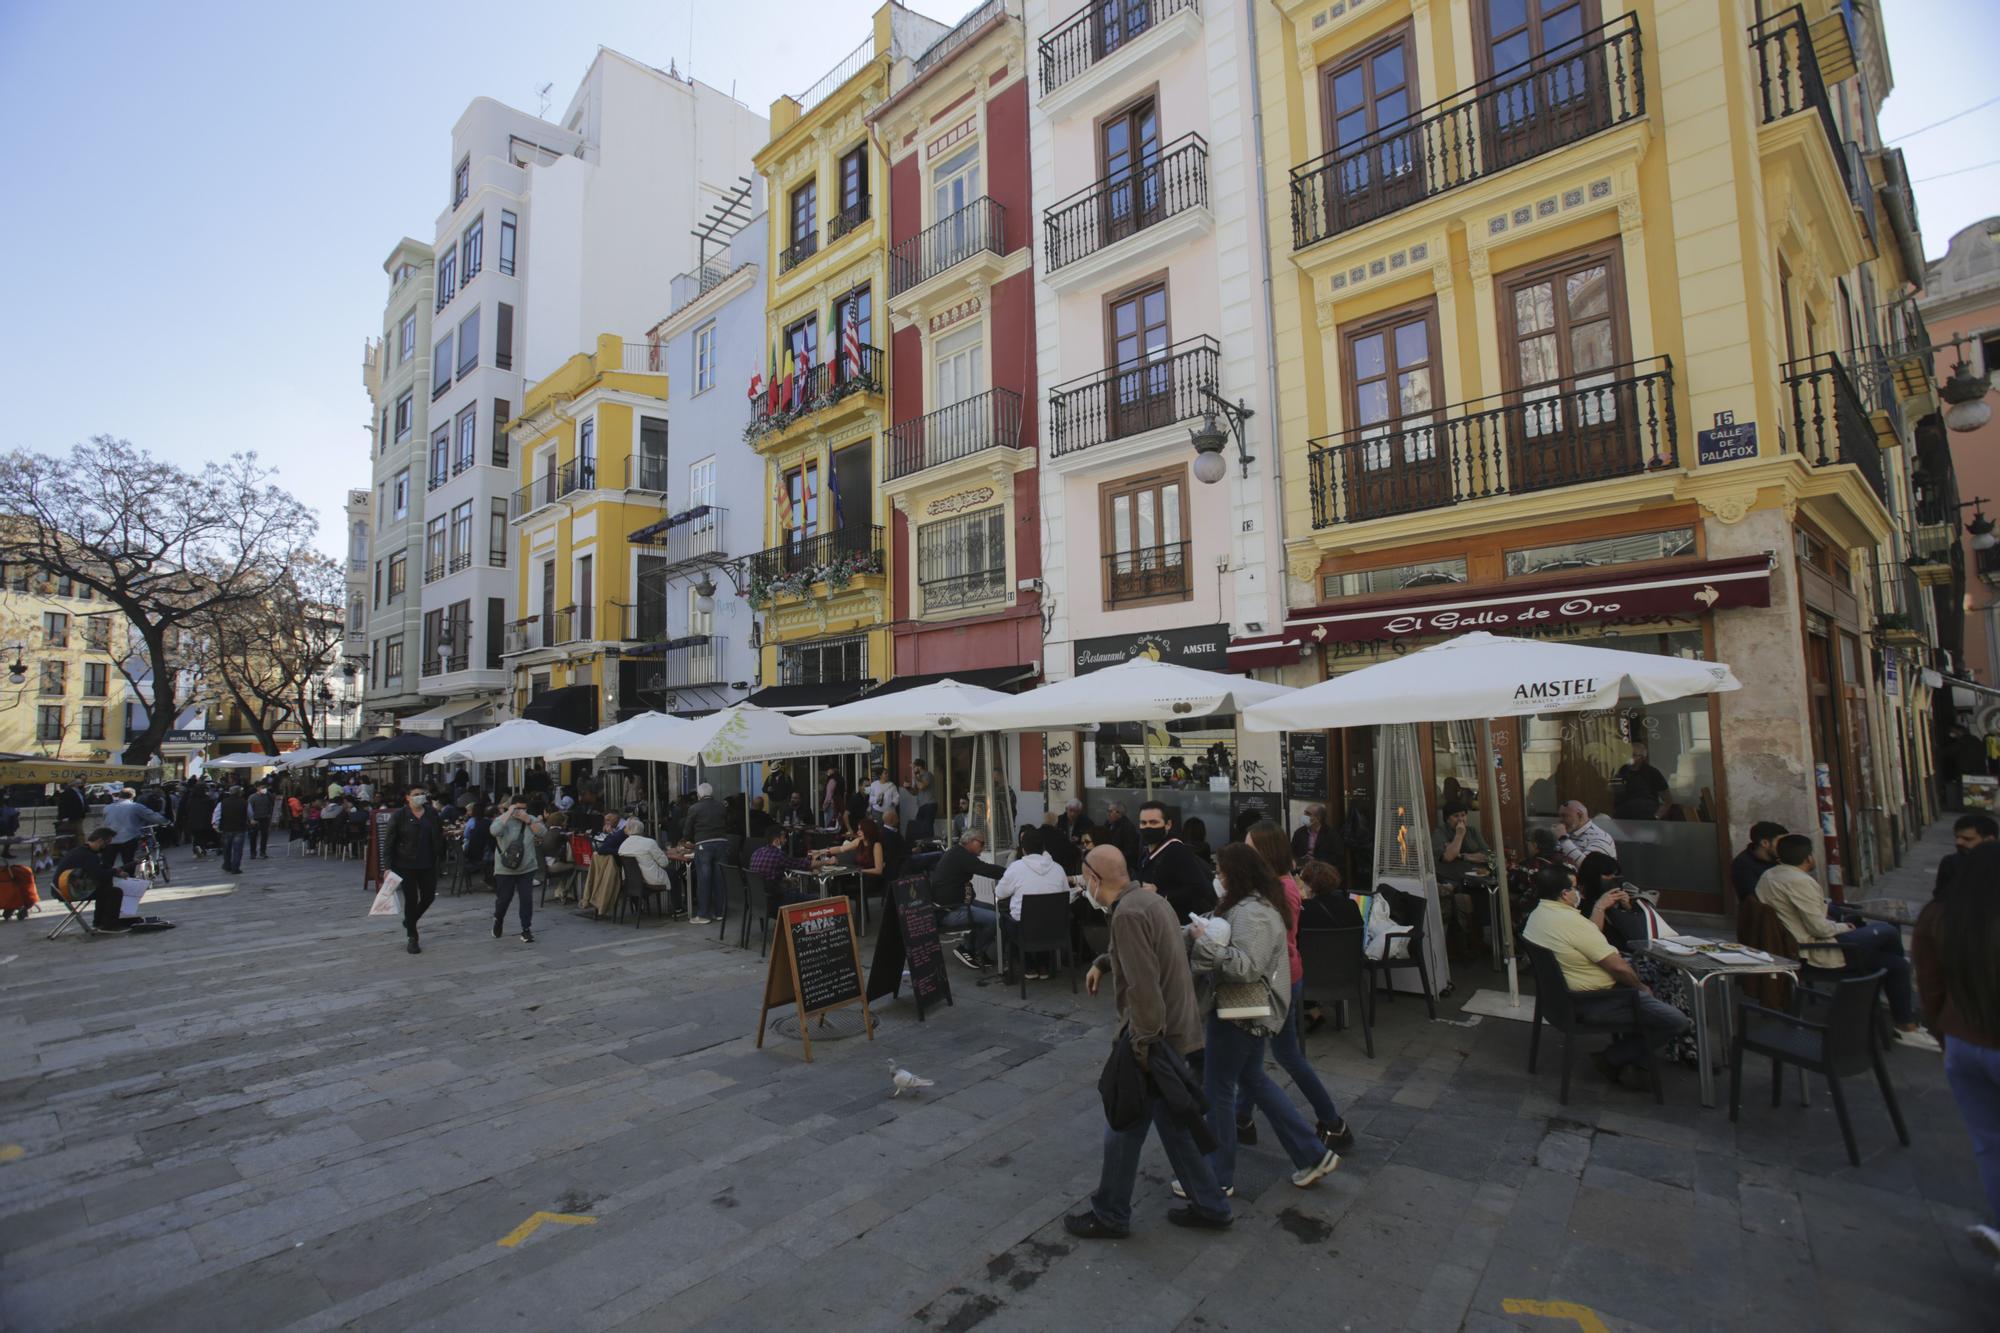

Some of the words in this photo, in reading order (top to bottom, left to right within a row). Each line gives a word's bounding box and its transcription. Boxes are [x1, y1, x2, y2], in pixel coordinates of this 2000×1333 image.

[1716, 412, 1733, 427] 15
[1710, 428, 1742, 440] CALLE
[1719, 440, 1735, 448] DE
[1701, 445, 1754, 462] PALAFOX
[1383, 617, 1422, 633] El
[1430, 608, 1509, 630] Gallo
[1517, 607, 1550, 621] de
[1560, 599, 1621, 615] Oro
[1183, 643, 1216, 655] AMSTEL
[1077, 650, 1126, 665] Restaurante
[1514, 678, 1597, 699] AMSTEL
